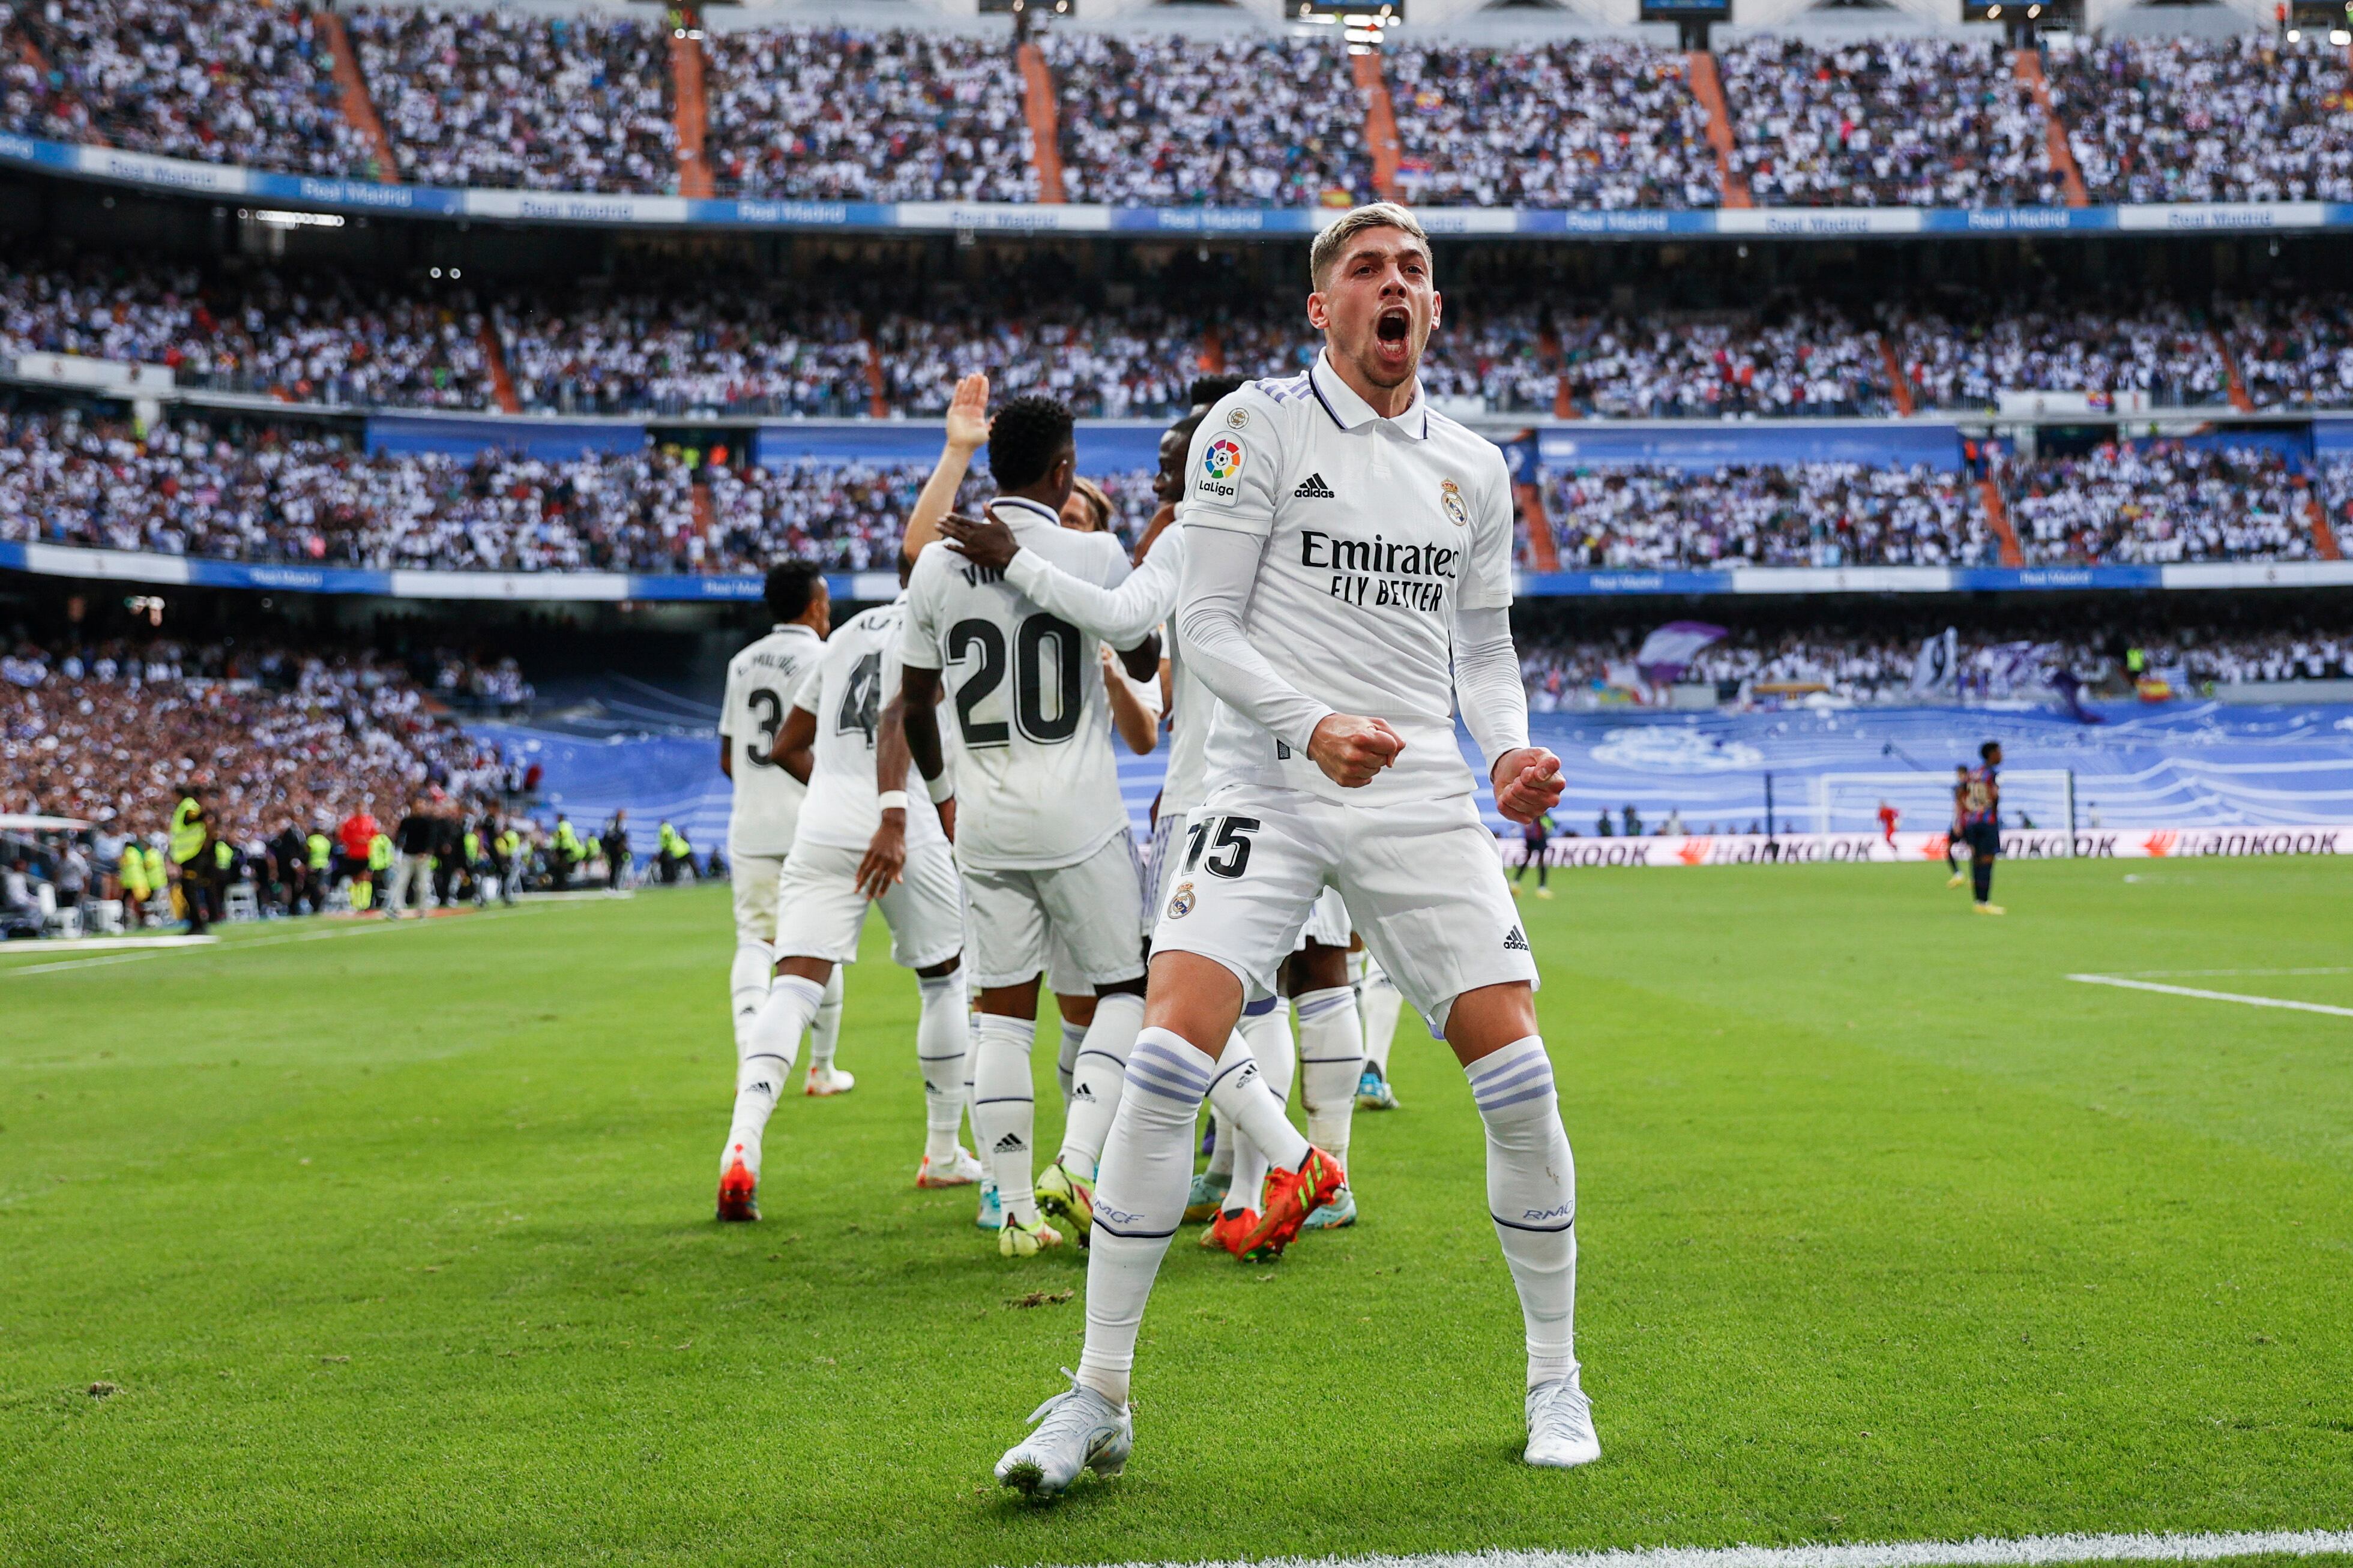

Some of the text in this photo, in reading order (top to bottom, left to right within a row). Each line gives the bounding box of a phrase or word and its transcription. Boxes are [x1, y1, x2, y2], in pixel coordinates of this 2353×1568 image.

[1199, 480, 1234, 496] LaLiga
[1294, 488, 1334, 498] adidas
[1301, 530, 1459, 578] Emirates
[1331, 576, 1442, 611] FLY BETTER
[836, 650, 882, 749] 4
[946, 613, 1081, 749] 20
[747, 688, 783, 768] 3
[1181, 816, 1261, 879] 15
[1094, 1198, 1145, 1224] MCF
[1523, 1200, 1574, 1219] RMC
